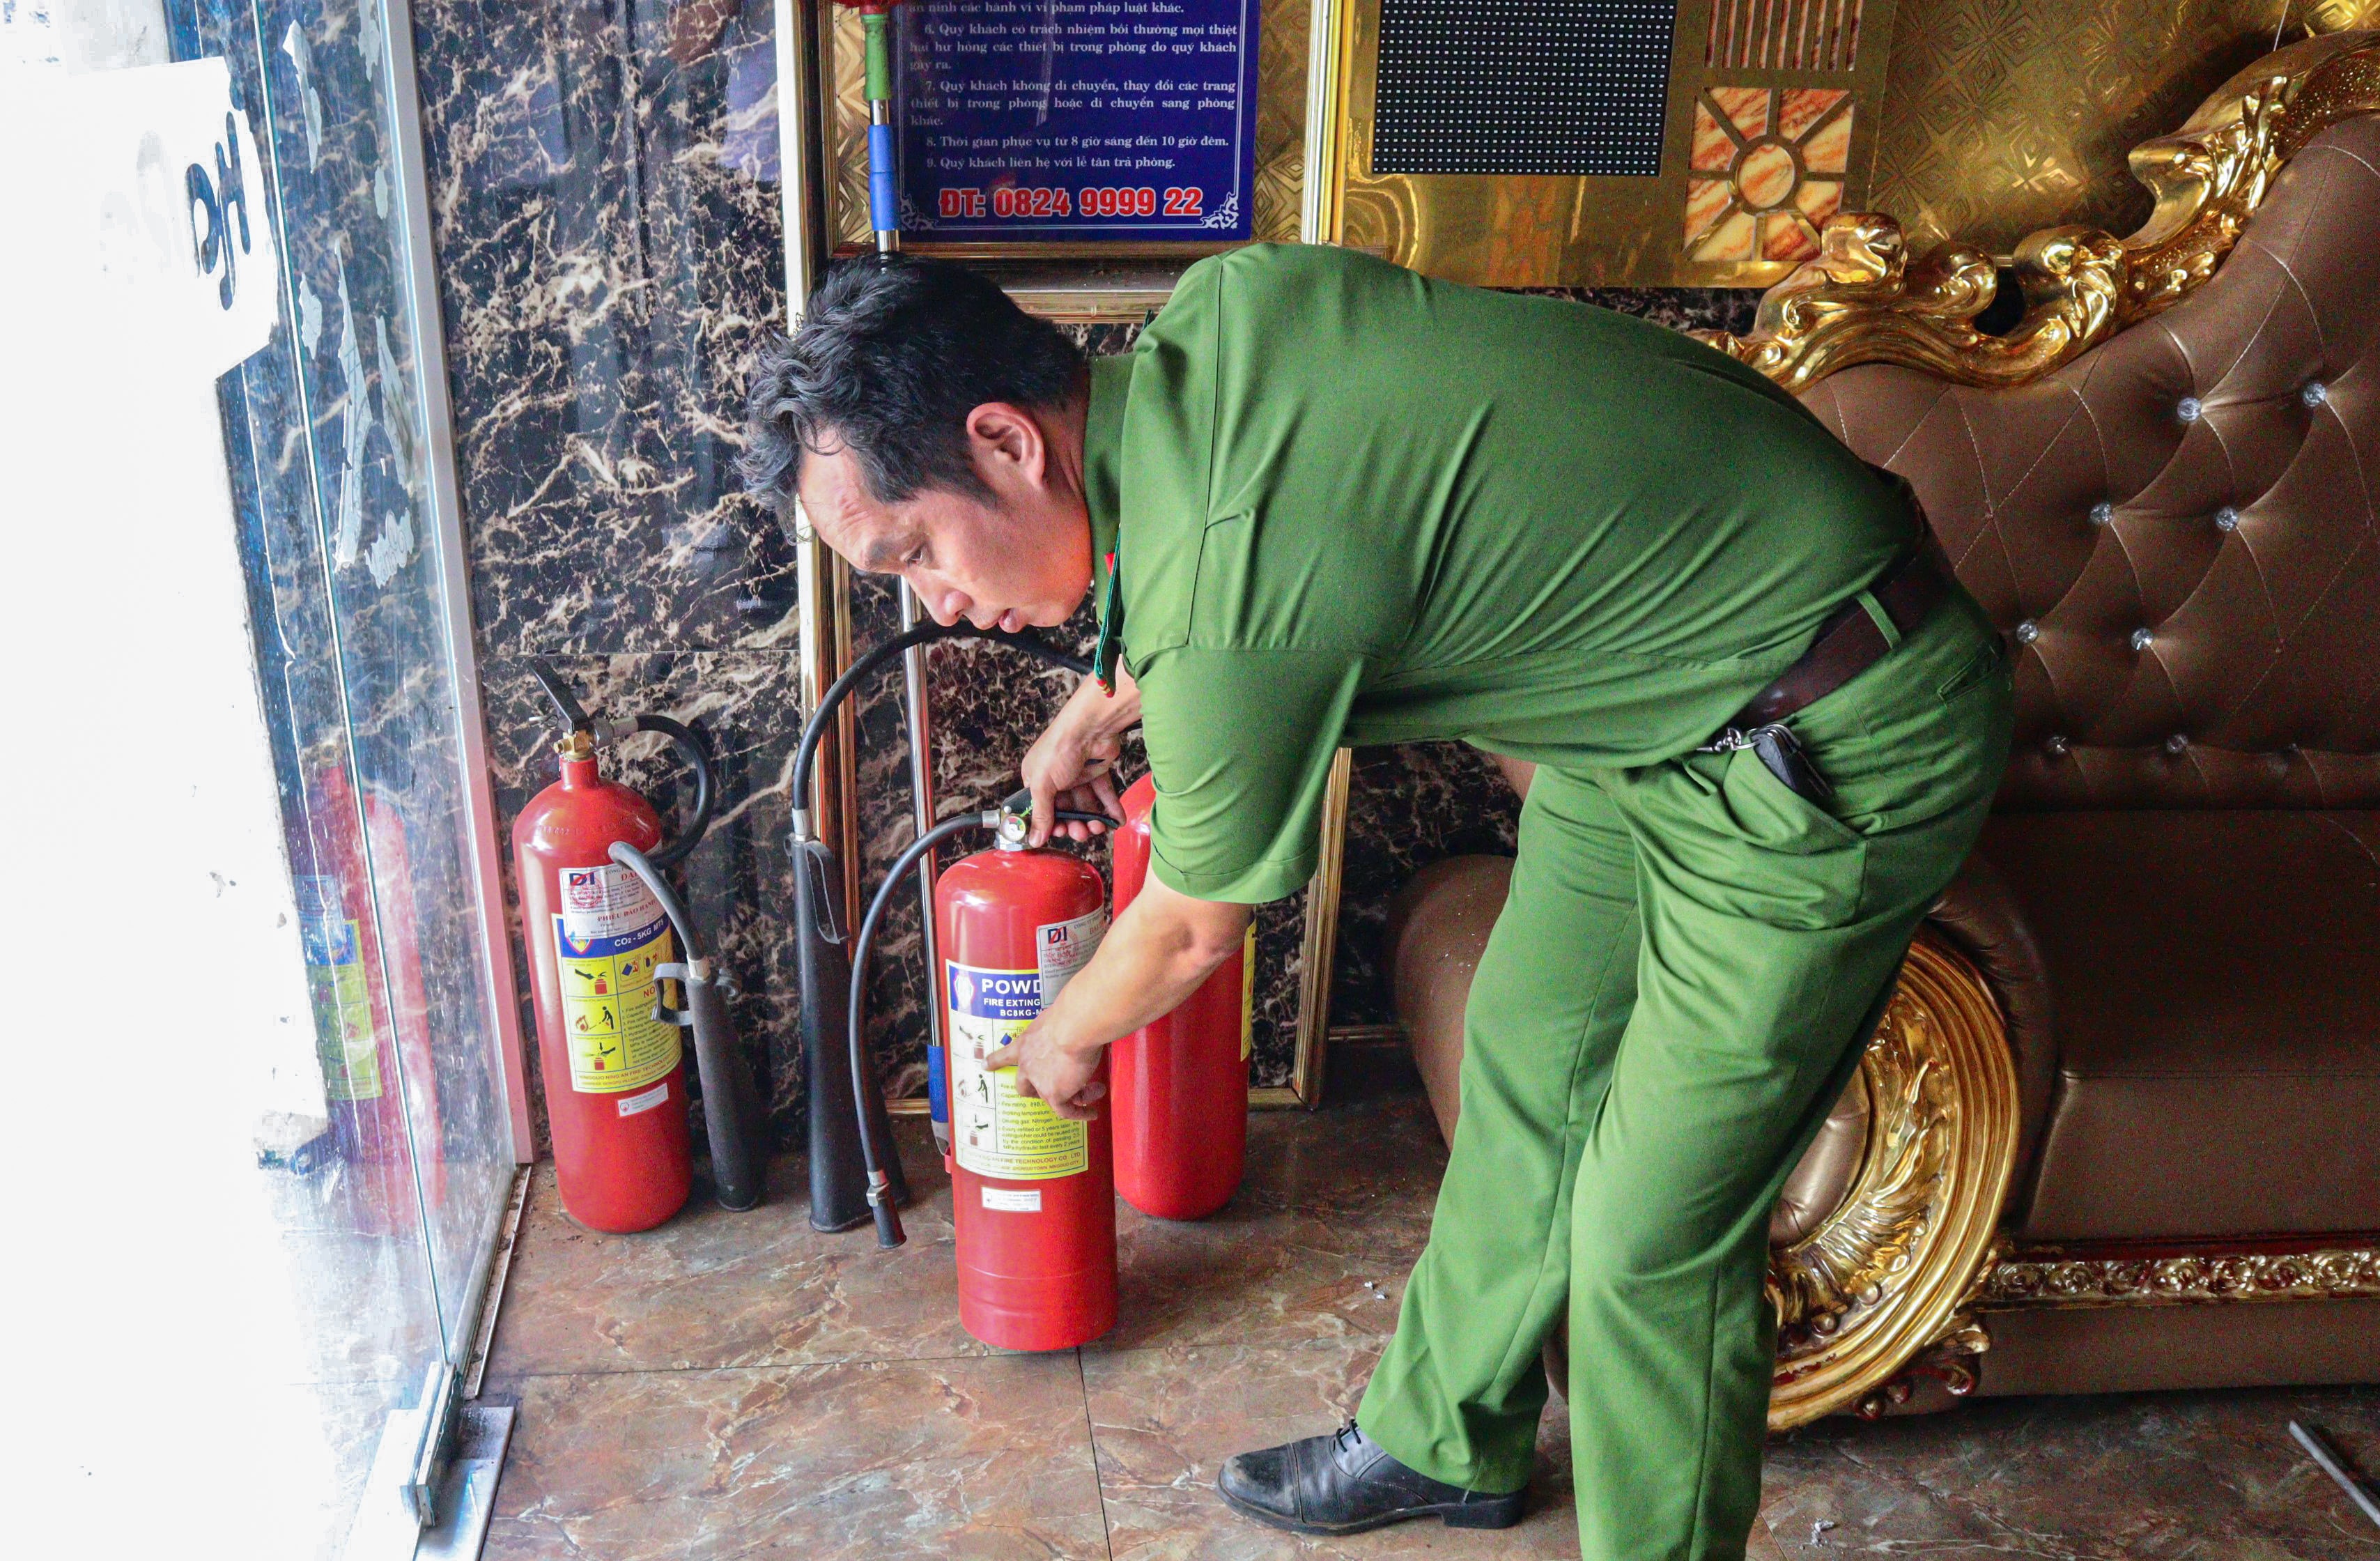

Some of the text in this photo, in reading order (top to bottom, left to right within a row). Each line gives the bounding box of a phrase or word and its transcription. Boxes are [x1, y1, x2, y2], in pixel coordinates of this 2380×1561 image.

[1071, 136, 1079, 146] 8
[1162, 136, 1175, 146] 10
[938, 187, 1203, 217] ĐT: 0824 9999 22
[638, 929, 652, 941] 5KG
[982, 978, 1040, 994] POWD
[983, 997, 1040, 1007] FIRE EXTING
[1015, 1155, 1058, 1164] TECHNOLOGY
